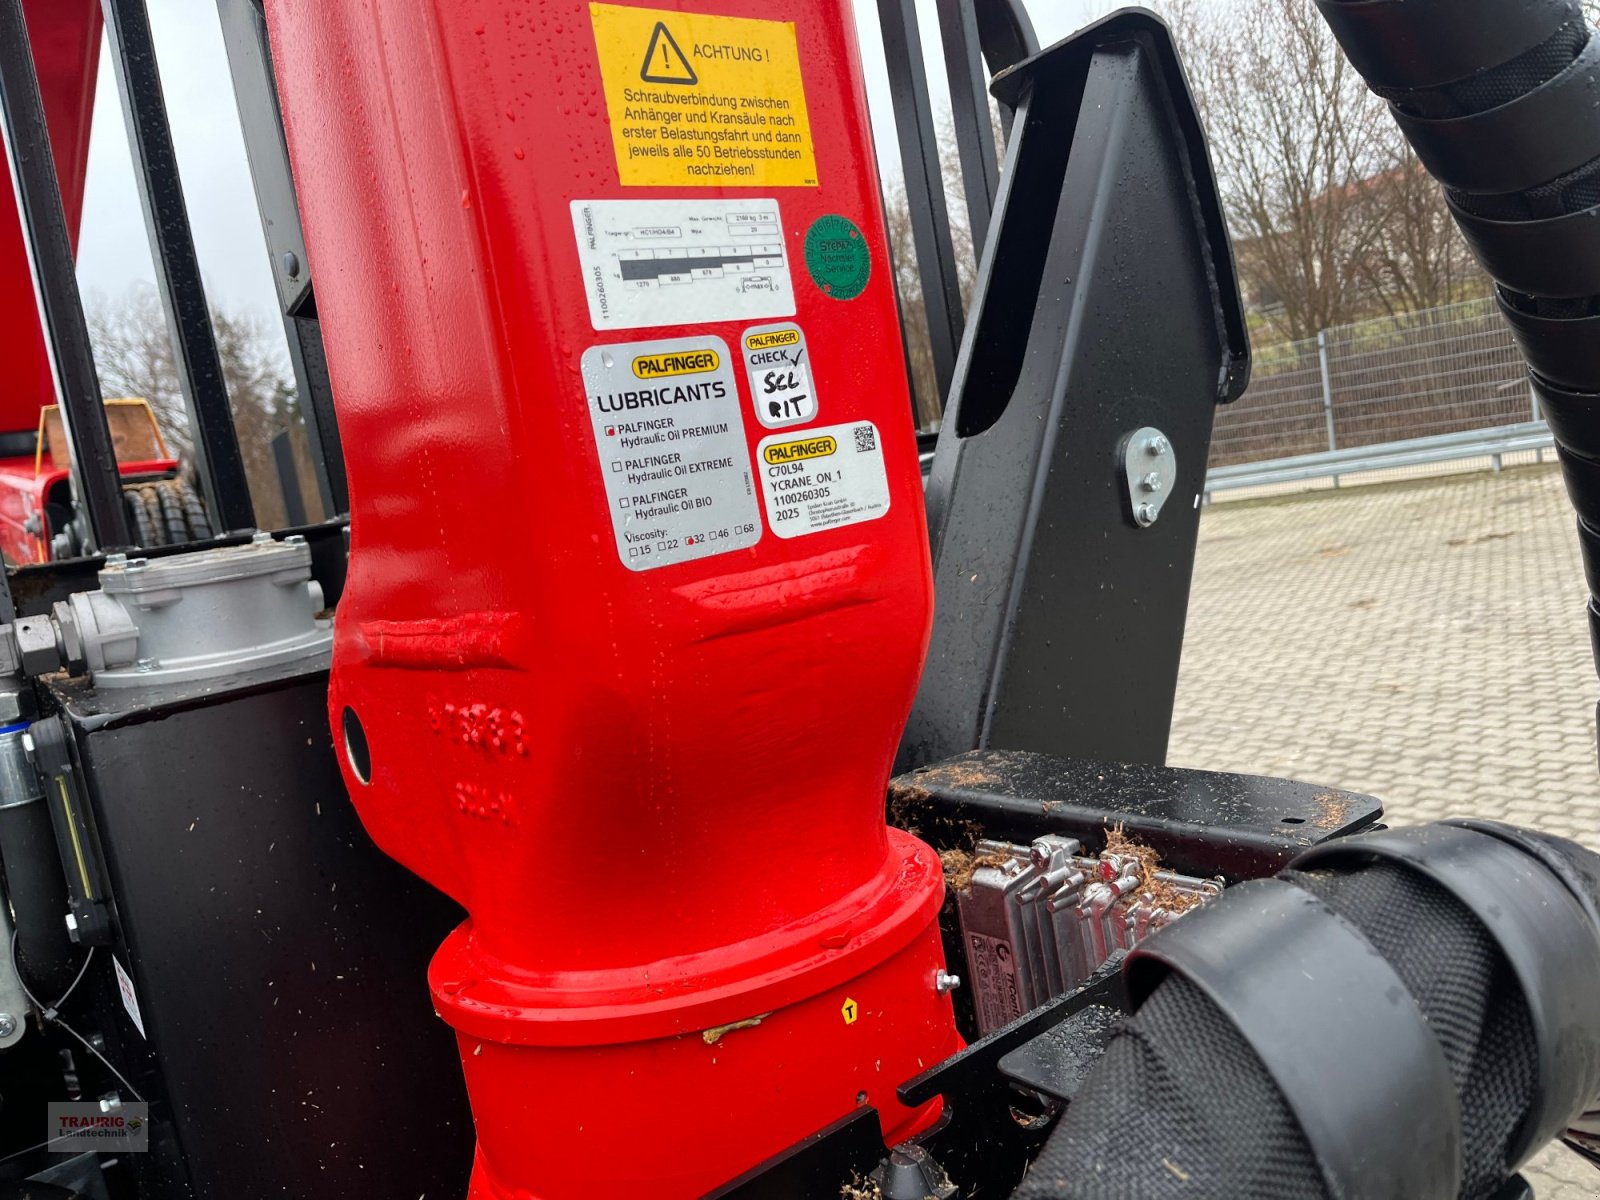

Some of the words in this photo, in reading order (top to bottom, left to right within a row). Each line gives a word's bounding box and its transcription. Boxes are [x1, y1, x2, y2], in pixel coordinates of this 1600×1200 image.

[693, 43, 762, 62] ACHTUNG
[623, 88, 738, 109] Schraubverbindung
[740, 97, 789, 109] zwischen
[624, 107, 682, 124] Anhänger
[686, 110, 707, 123] und
[710, 112, 766, 126] Kransäule
[769, 114, 795, 126] nach
[622, 127, 657, 139] erster
[661, 128, 749, 144] Belastungsfahrt
[752, 130, 772, 143] und
[775, 131, 801, 143] dann
[628, 144, 670, 159] jeweils
[673, 145, 693, 158] alle
[696, 146, 711, 158] 50
[714, 146, 801, 160] Betriebsstunden
[687, 164, 755, 176] nachziehen!
[583, 207, 597, 250] PALFINGER
[593, 265, 609, 320] 1100260305
[749, 332, 797, 347] PALFINGER
[638, 353, 714, 375] PALFINGER
[750, 349, 789, 365] CHECK
[597, 381, 726, 413] LUBRICANTS
[618, 418, 674, 435] PALFINGER
[620, 432, 666, 449] Hydraulic
[668, 429, 680, 441] Oil
[682, 423, 729, 439] PREMIUM
[769, 439, 832, 461] PALFINGER
[625, 453, 681, 470] PALFINGER
[627, 467, 672, 485] Hydraulic
[674, 465, 687, 476] Oil
[689, 457, 733, 474] EXTREME
[768, 462, 804, 478] C70L94
[632, 488, 688, 506] PALFINGER
[773, 487, 831, 507] 1100260305
[635, 502, 680, 520] Hydraulic
[681, 500, 694, 511] Oil
[695, 496, 713, 508] BIO
[776, 508, 800, 521] 2025
[624, 528, 668, 544] Viscosity:
[639, 545, 652, 556] 15
[667, 539, 679, 550] 22
[694, 534, 705, 544] 32
[718, 529, 729, 538] 46
[743, 523, 755, 533] 68
[845, 1004, 854, 1019] T
